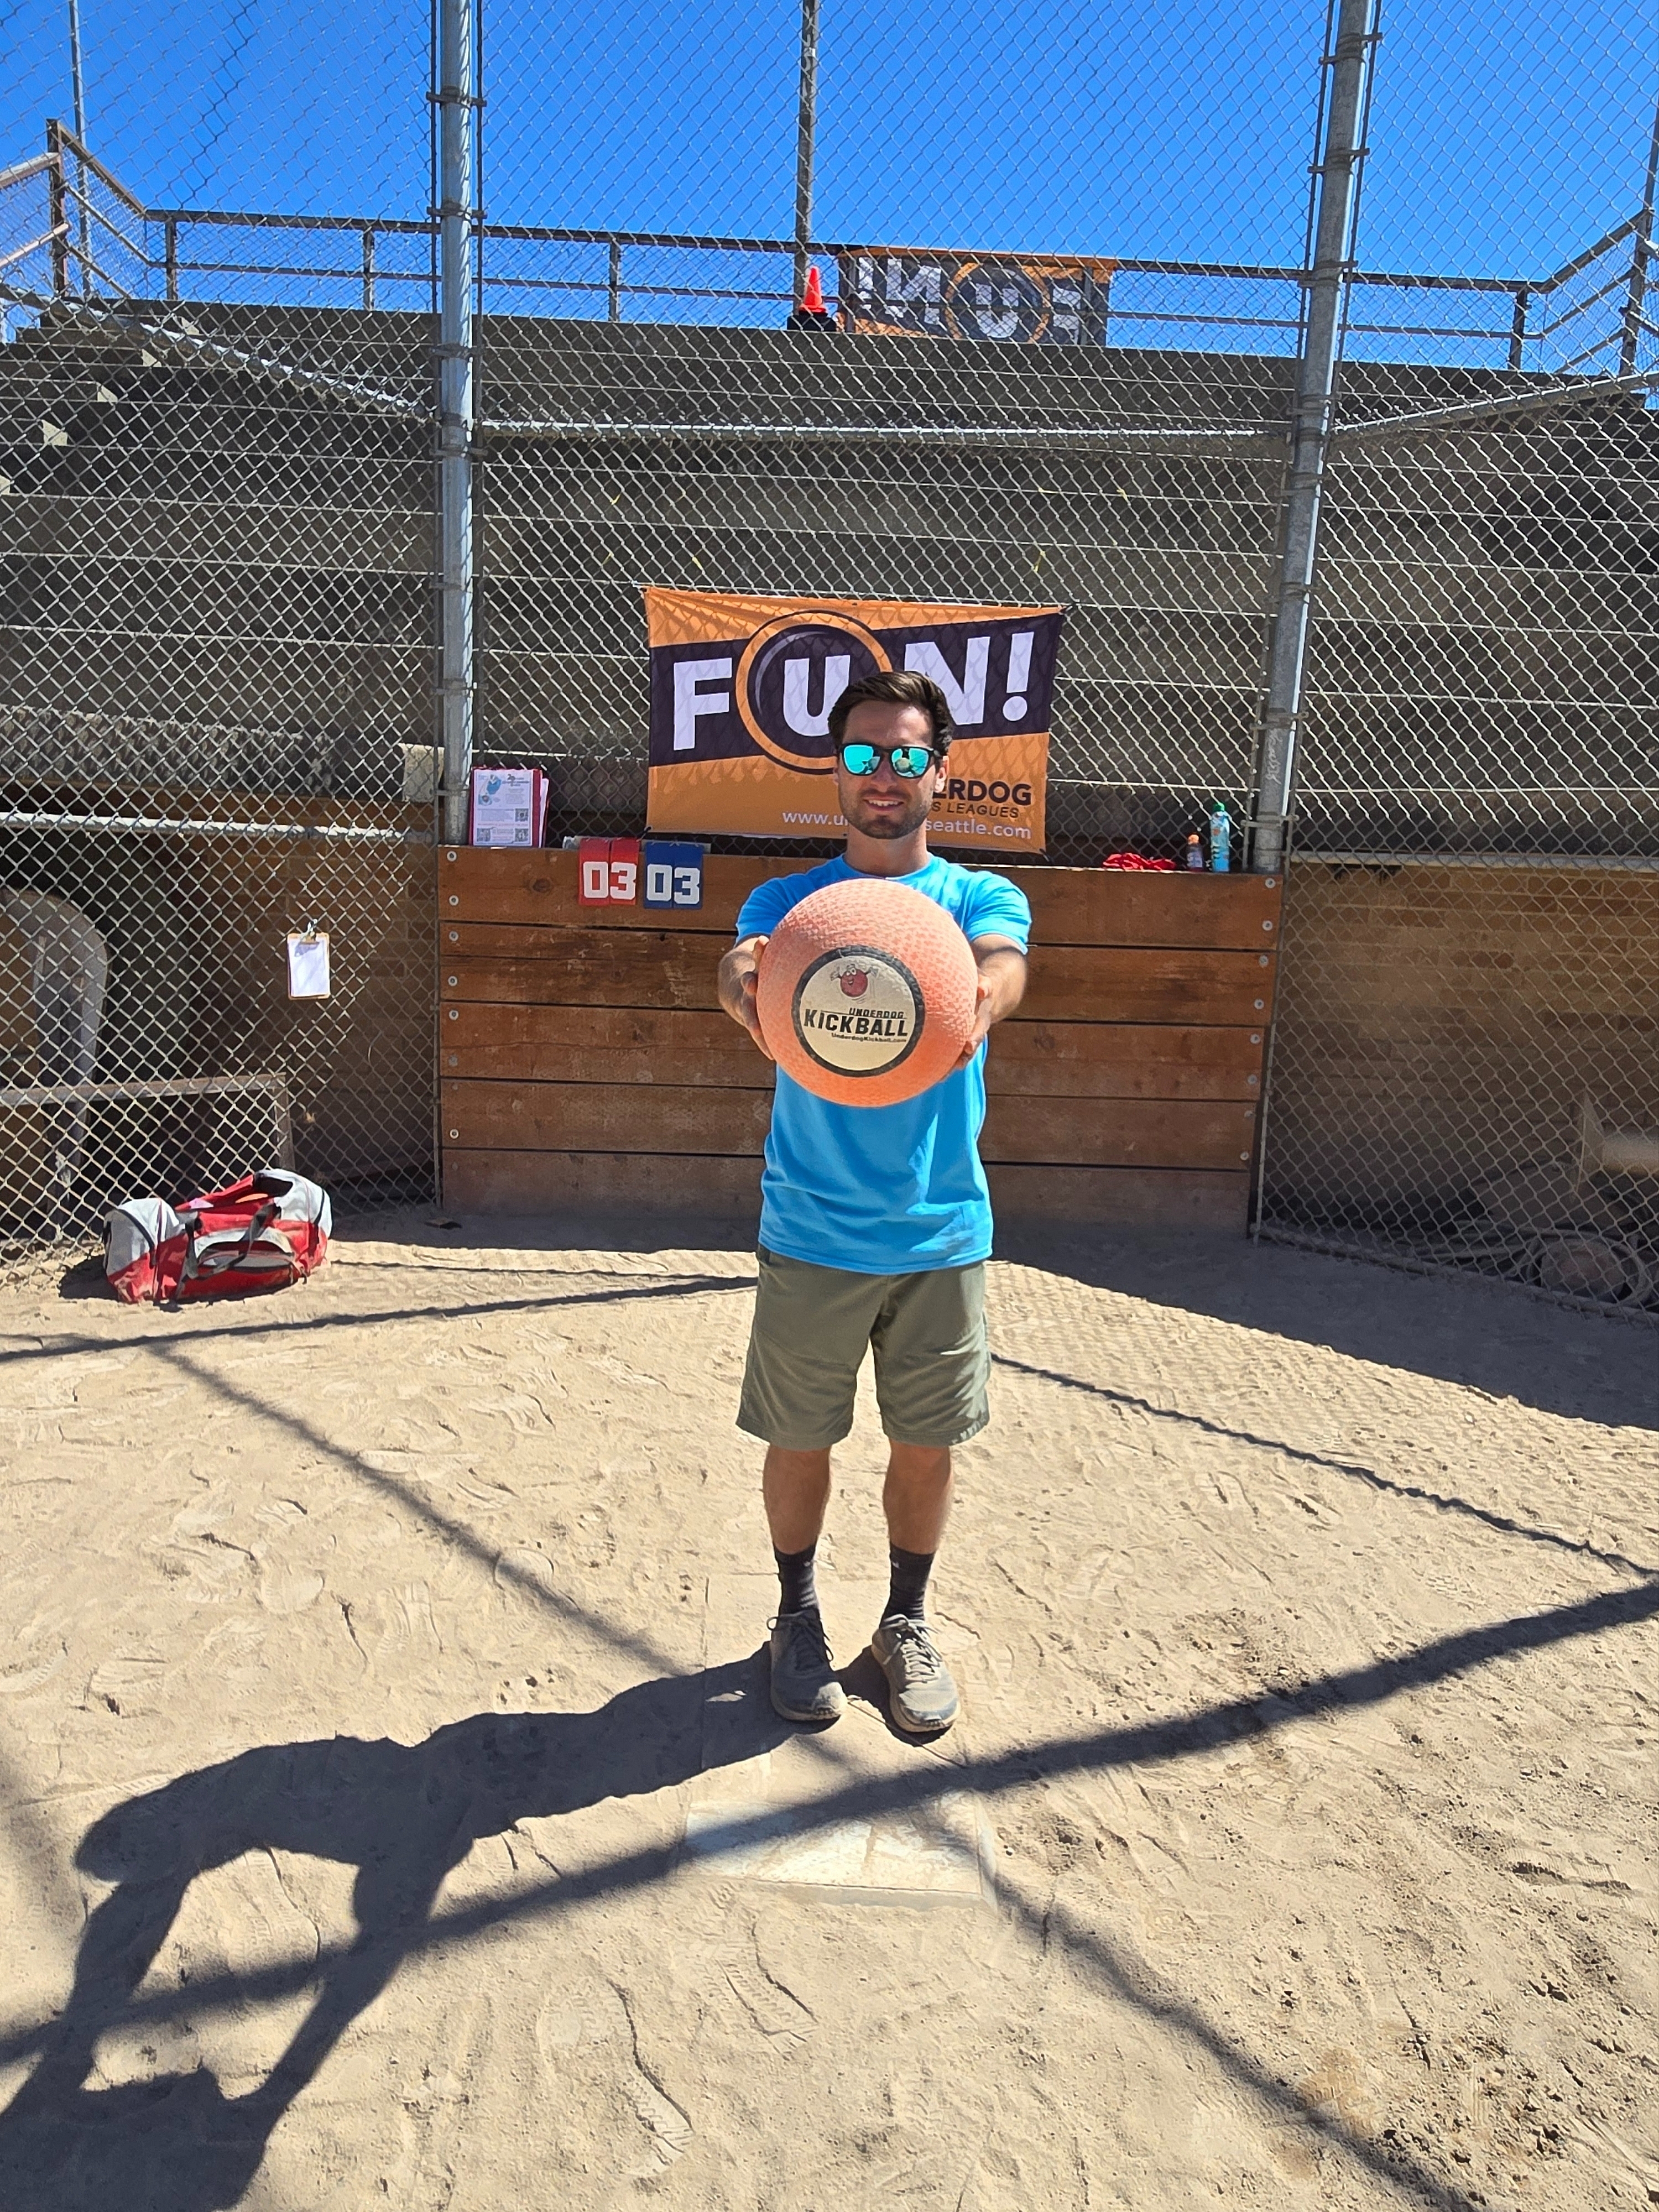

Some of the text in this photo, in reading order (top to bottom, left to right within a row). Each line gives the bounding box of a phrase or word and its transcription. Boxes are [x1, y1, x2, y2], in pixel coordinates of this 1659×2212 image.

[672, 632, 1034, 751] FUN!
[947, 803, 1019, 818] LEAGUES
[782, 812, 1031, 839] www.useattle.com
[583, 861, 637, 900] 03
[646, 863, 700, 904] 03
[804, 1009, 908, 1036] KICKBALL
[849, 1008, 904, 1019] UNDERDOG
